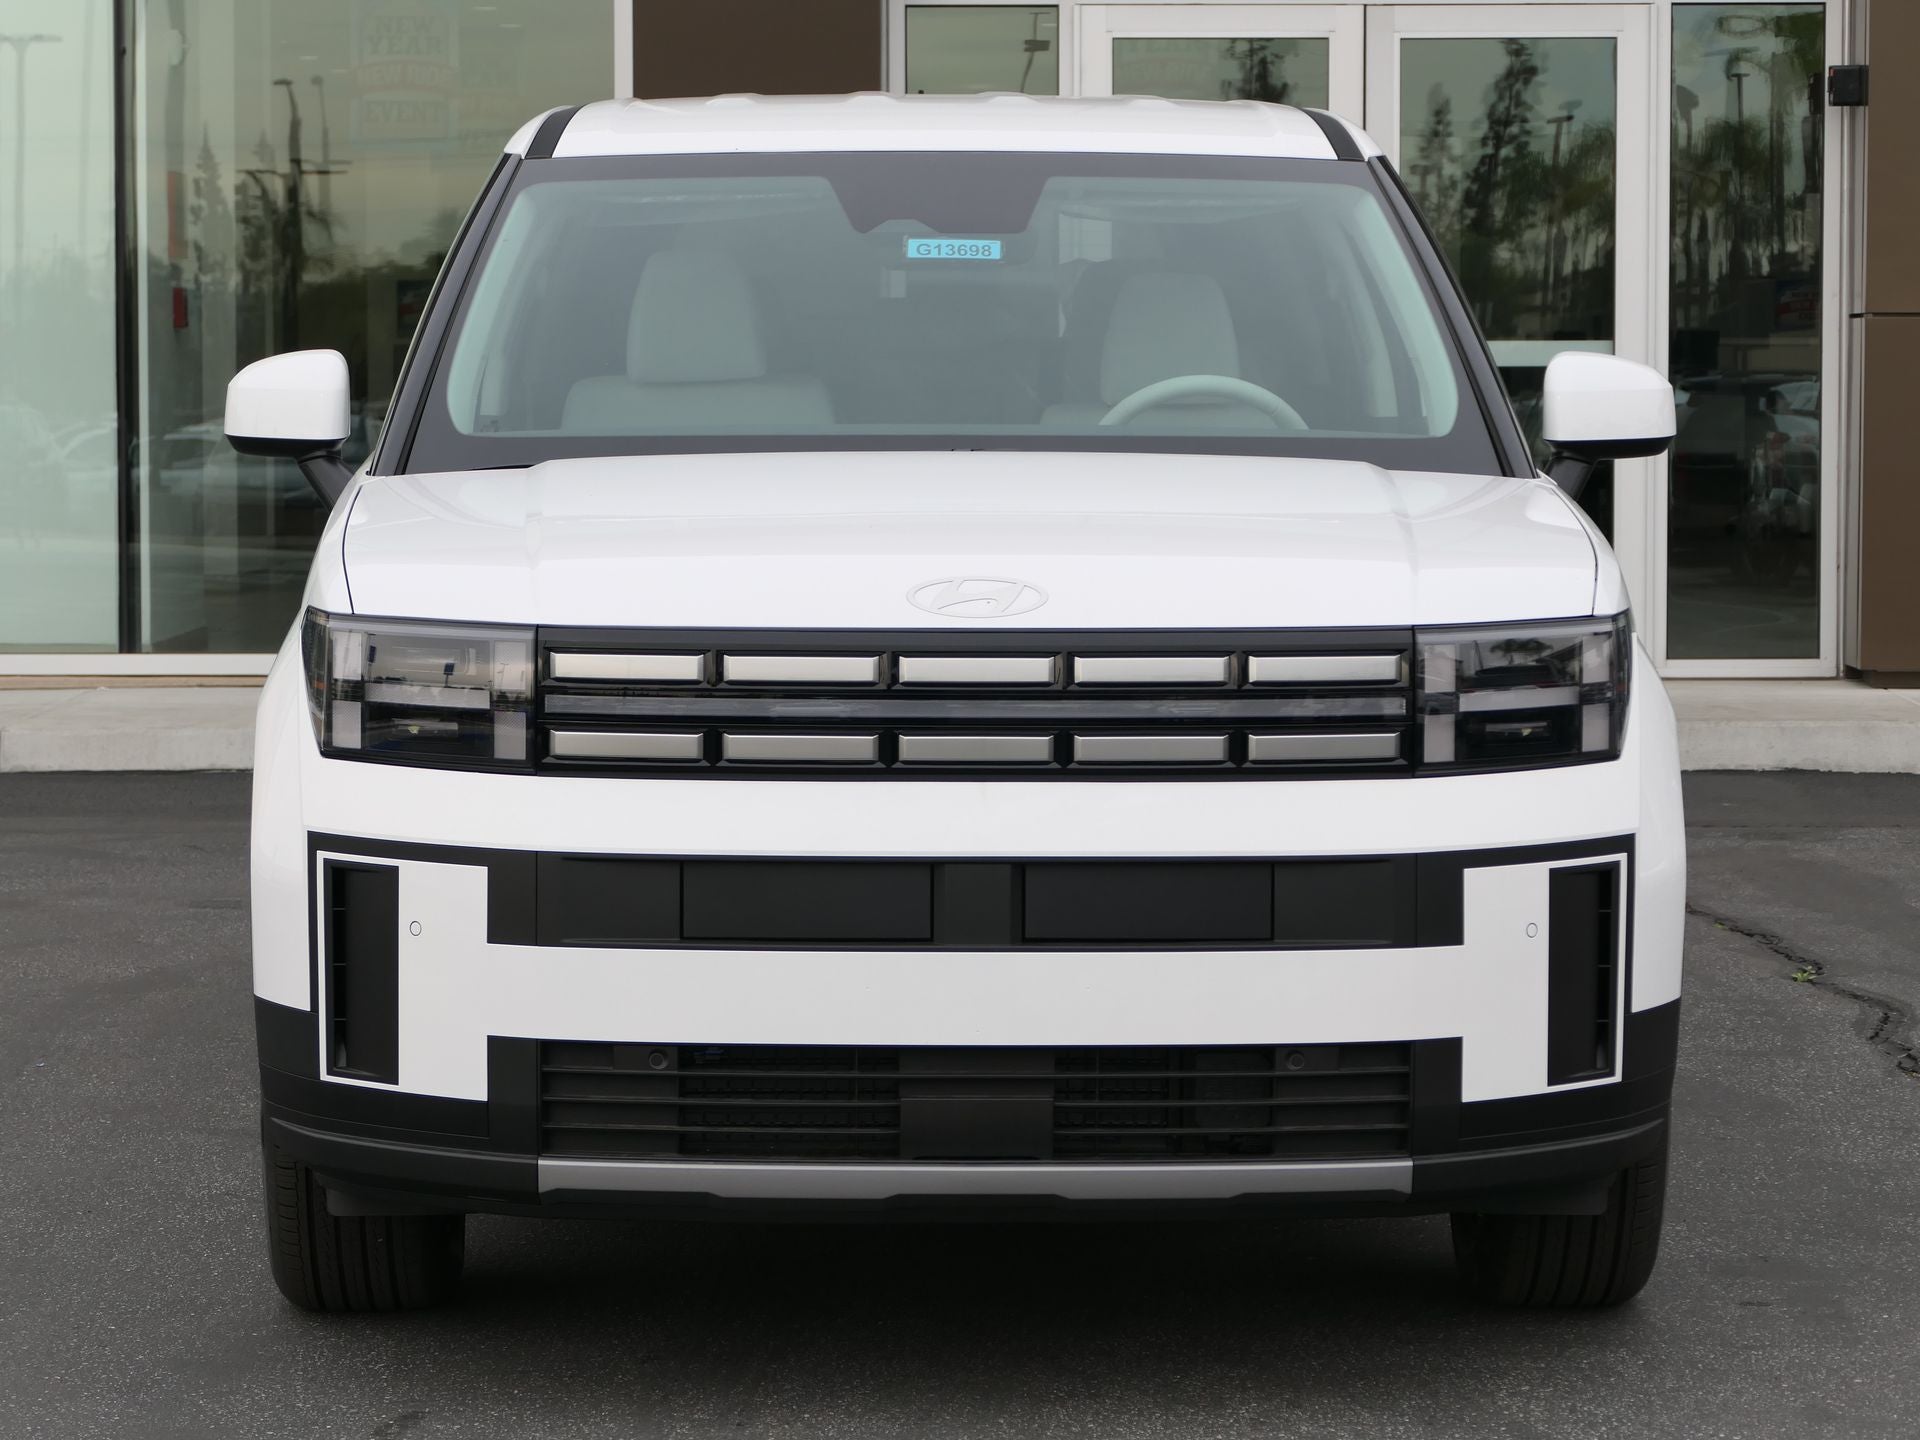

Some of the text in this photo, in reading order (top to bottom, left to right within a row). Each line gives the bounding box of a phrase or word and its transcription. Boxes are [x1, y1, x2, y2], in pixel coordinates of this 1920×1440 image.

[376, 15, 436, 34] NEW
[367, 35, 442, 55] YEAR
[366, 101, 443, 123] EVENT
[916, 243, 992, 257] G13698
